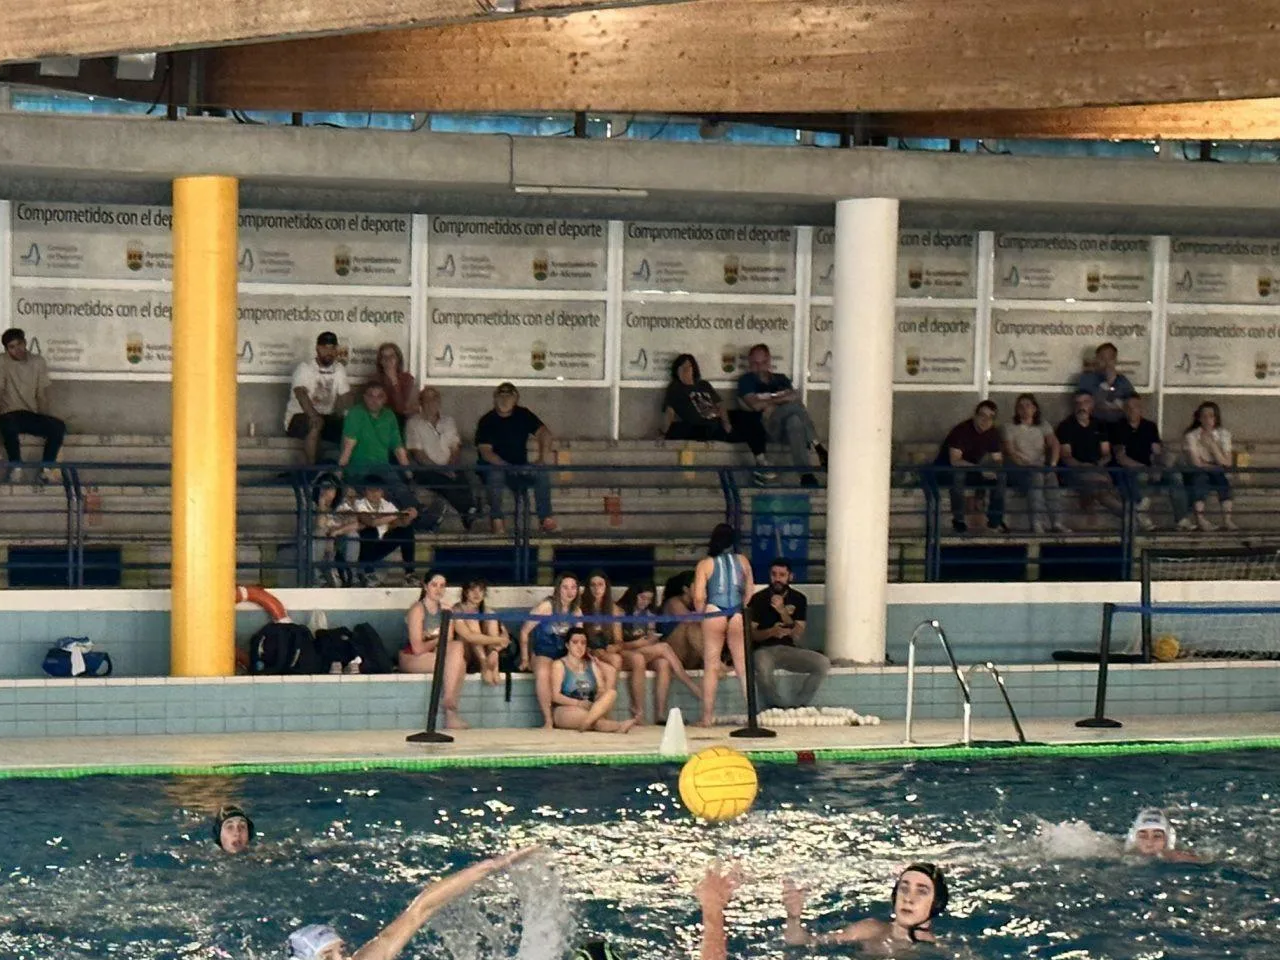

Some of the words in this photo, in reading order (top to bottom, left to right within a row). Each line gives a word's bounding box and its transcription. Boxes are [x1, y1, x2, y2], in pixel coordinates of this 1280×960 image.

[17, 203, 114, 226] Comprometidos
[116, 211, 138, 225] con
[140, 209, 152, 226] el
[238, 213, 323, 231] omprometidos
[325, 217, 345, 230] con
[348, 214, 359, 231] el
[361, 215, 406, 235] deporte
[433, 216, 522, 237] Comprometidos
[524, 222, 544, 236] con
[547, 220, 557, 236] el
[559, 221, 602, 240] deporte
[628, 222, 713, 242] Comprometidos
[715, 228, 734, 241] con
[738, 225, 747, 241] el
[749, 226, 790, 245] deporte
[900, 235, 919, 246] con
[922, 231, 931, 247] el
[933, 230, 973, 250] deporte
[17, 297, 114, 319] Comprometidos
[116, 304, 138, 318] con
[140, 302, 152, 318] el
[237, 306, 321, 324] omprometidos
[323, 310, 344, 322] con
[347, 307, 357, 323] el
[360, 308, 405, 327] deporte
[432, 307, 521, 328] Comprometidos
[522, 313, 543, 326] con
[545, 310, 555, 326] el
[557, 311, 600, 331] deporte
[626, 311, 711, 332] Comprometidos
[713, 317, 733, 330] con
[735, 314, 745, 330] el
[746, 315, 789, 333] deporte
[898, 320, 917, 333] con
[919, 317, 928, 333] el
[930, 317, 970, 336] deporte
